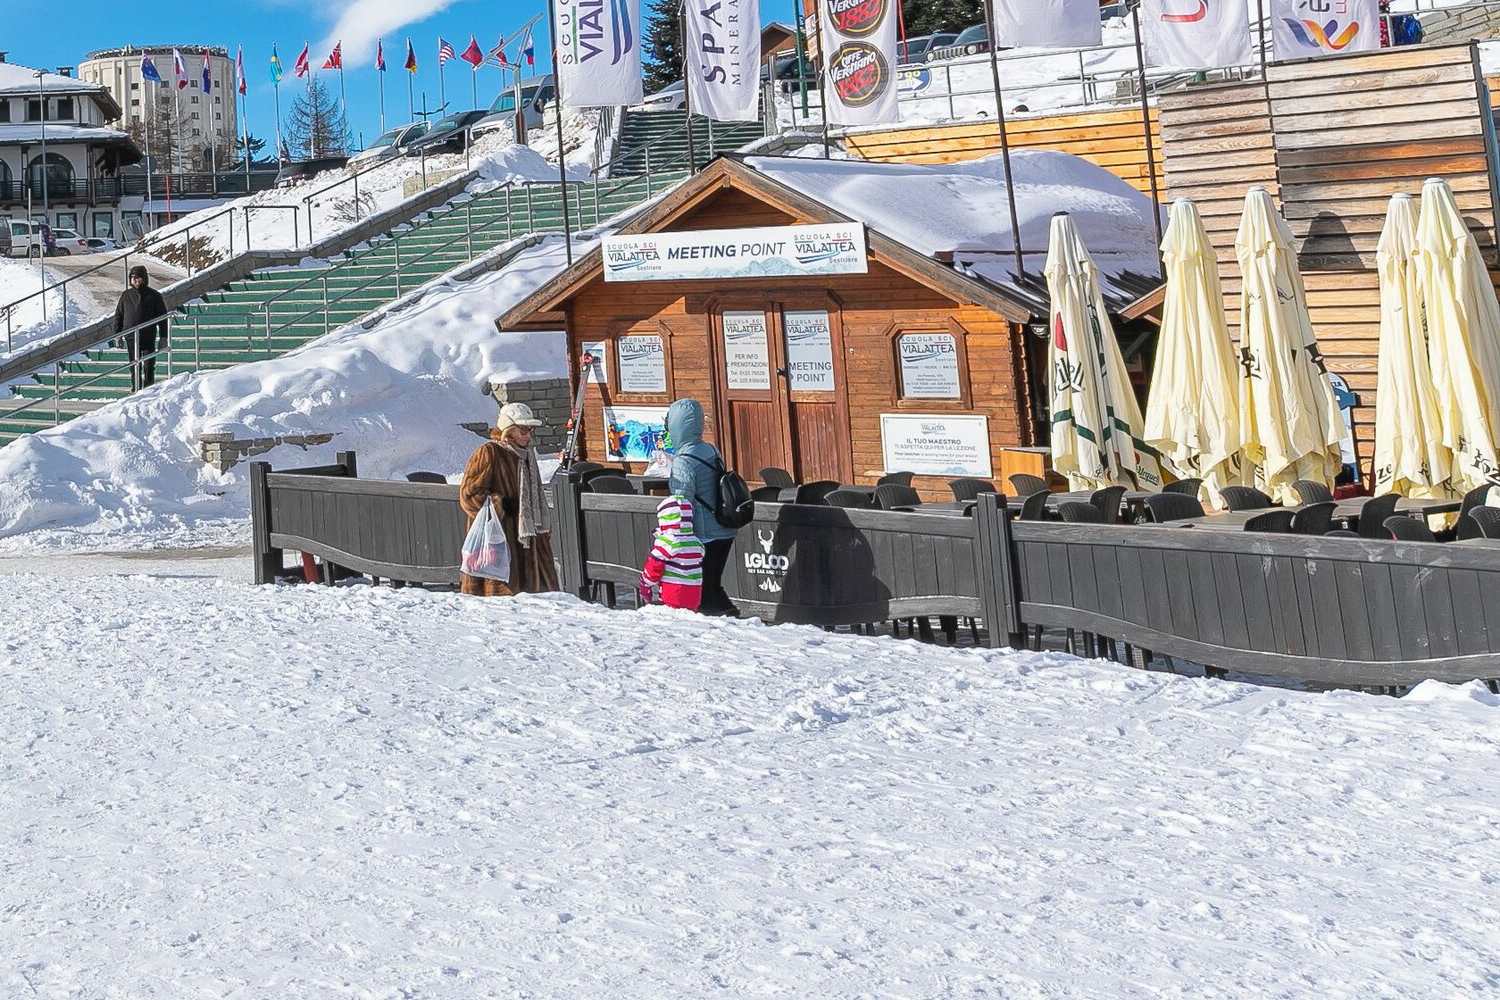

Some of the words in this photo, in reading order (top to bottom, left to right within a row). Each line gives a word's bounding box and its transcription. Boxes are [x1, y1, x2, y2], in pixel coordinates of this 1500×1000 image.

[668, 245, 736, 260] MEETING
[740, 242, 786, 257] POINT
[795, 242, 856, 253] VIALATTEA
[608, 251, 660, 262] VIALATTEA
[621, 345, 663, 353] VIALATTEA
[902, 344, 955, 353] VIALATTEA
[789, 362, 832, 370] MEETING
[796, 373, 825, 382] POINT
